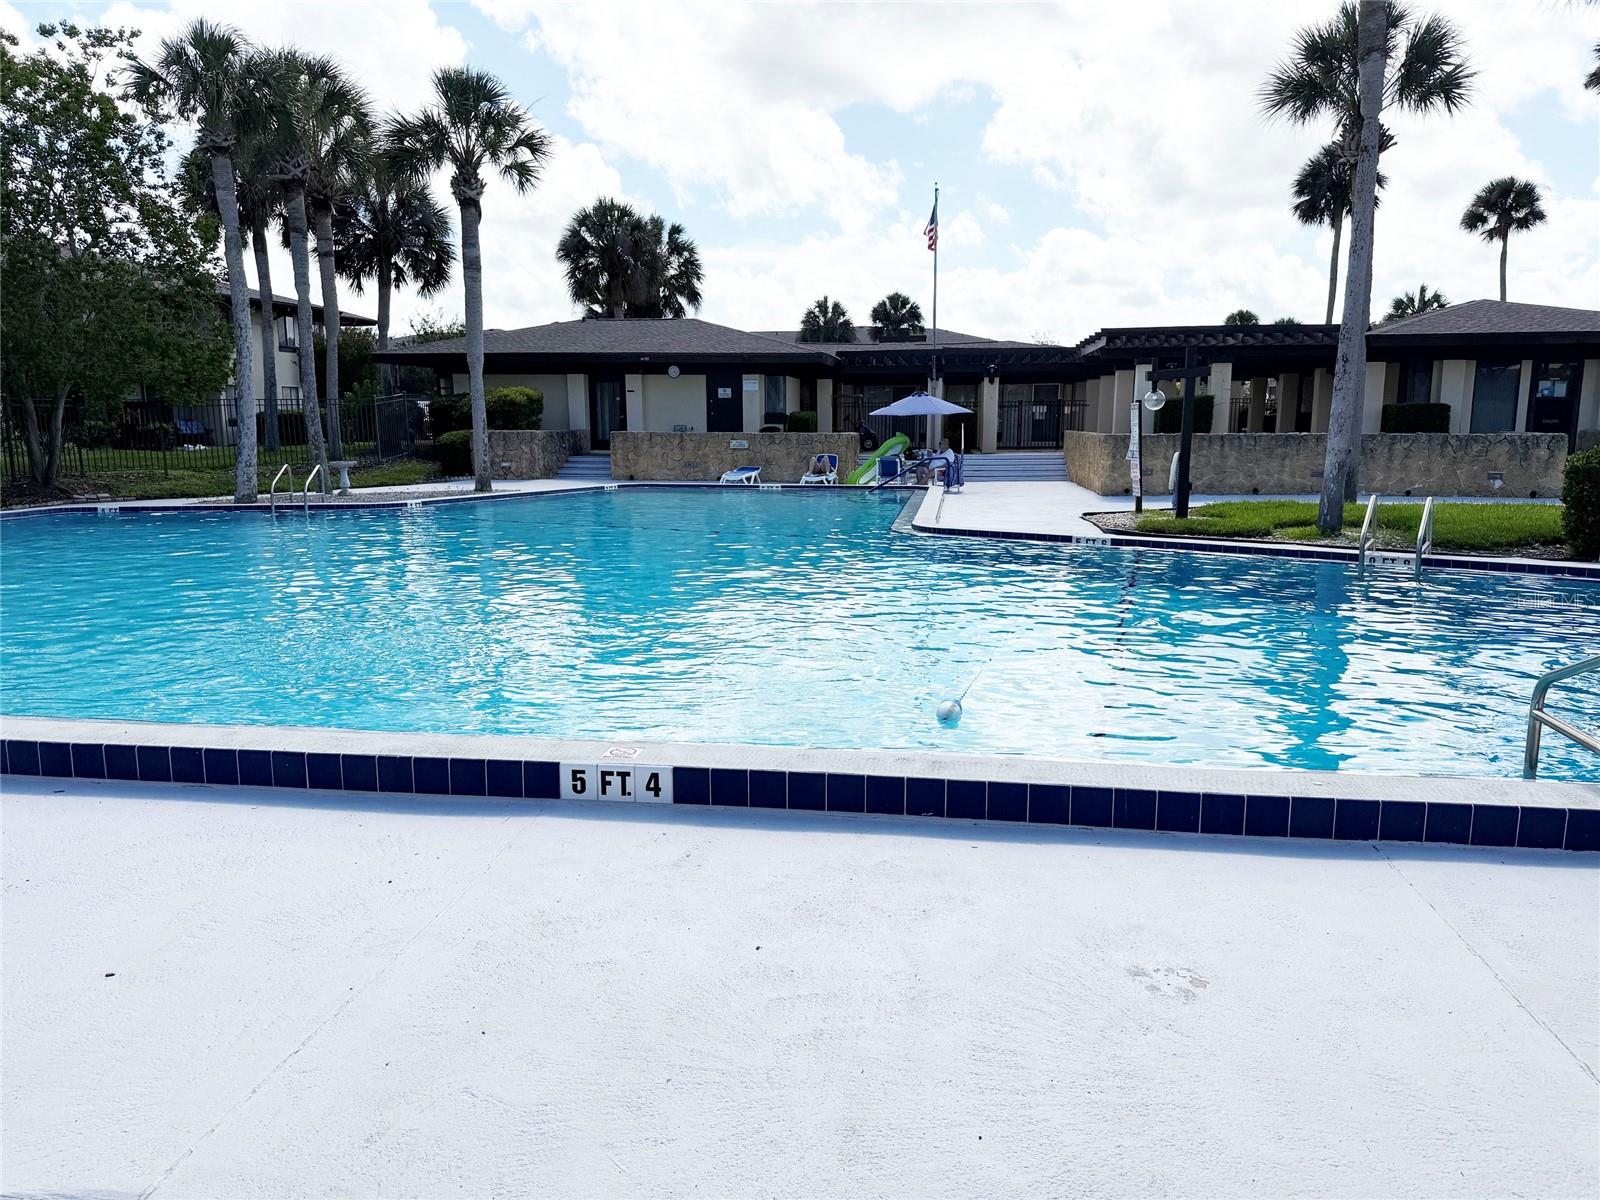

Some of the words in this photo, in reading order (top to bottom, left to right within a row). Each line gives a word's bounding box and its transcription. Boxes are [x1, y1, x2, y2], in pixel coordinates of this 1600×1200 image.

[571, 769, 587, 794] 5
[600, 770, 631, 796] FT.
[645, 772, 661, 797] 4
